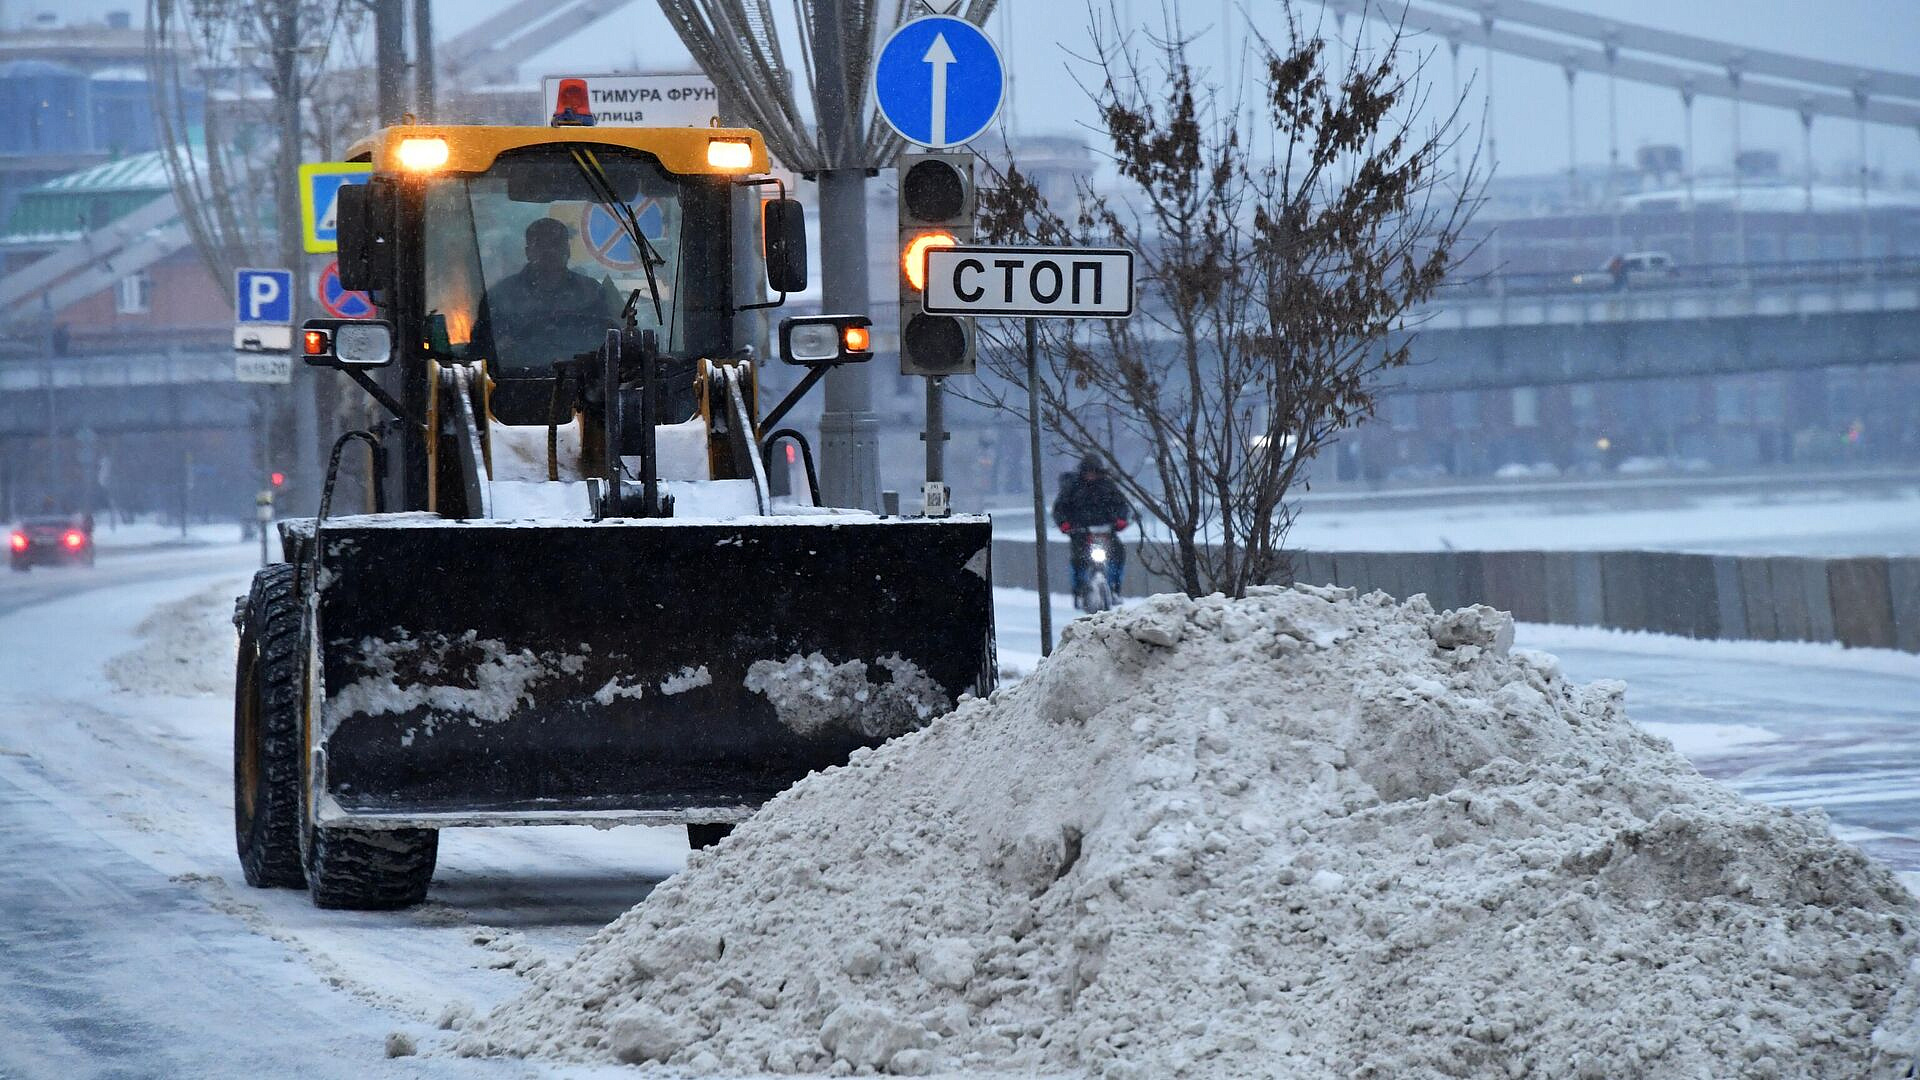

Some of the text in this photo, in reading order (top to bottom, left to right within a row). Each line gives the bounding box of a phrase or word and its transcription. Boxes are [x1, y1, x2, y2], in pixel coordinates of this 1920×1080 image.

[592, 88, 662, 103] ТИМУРА
[593, 111, 643, 124] улица
[953, 258, 1103, 305] СТОП
[250, 275, 280, 319] P
